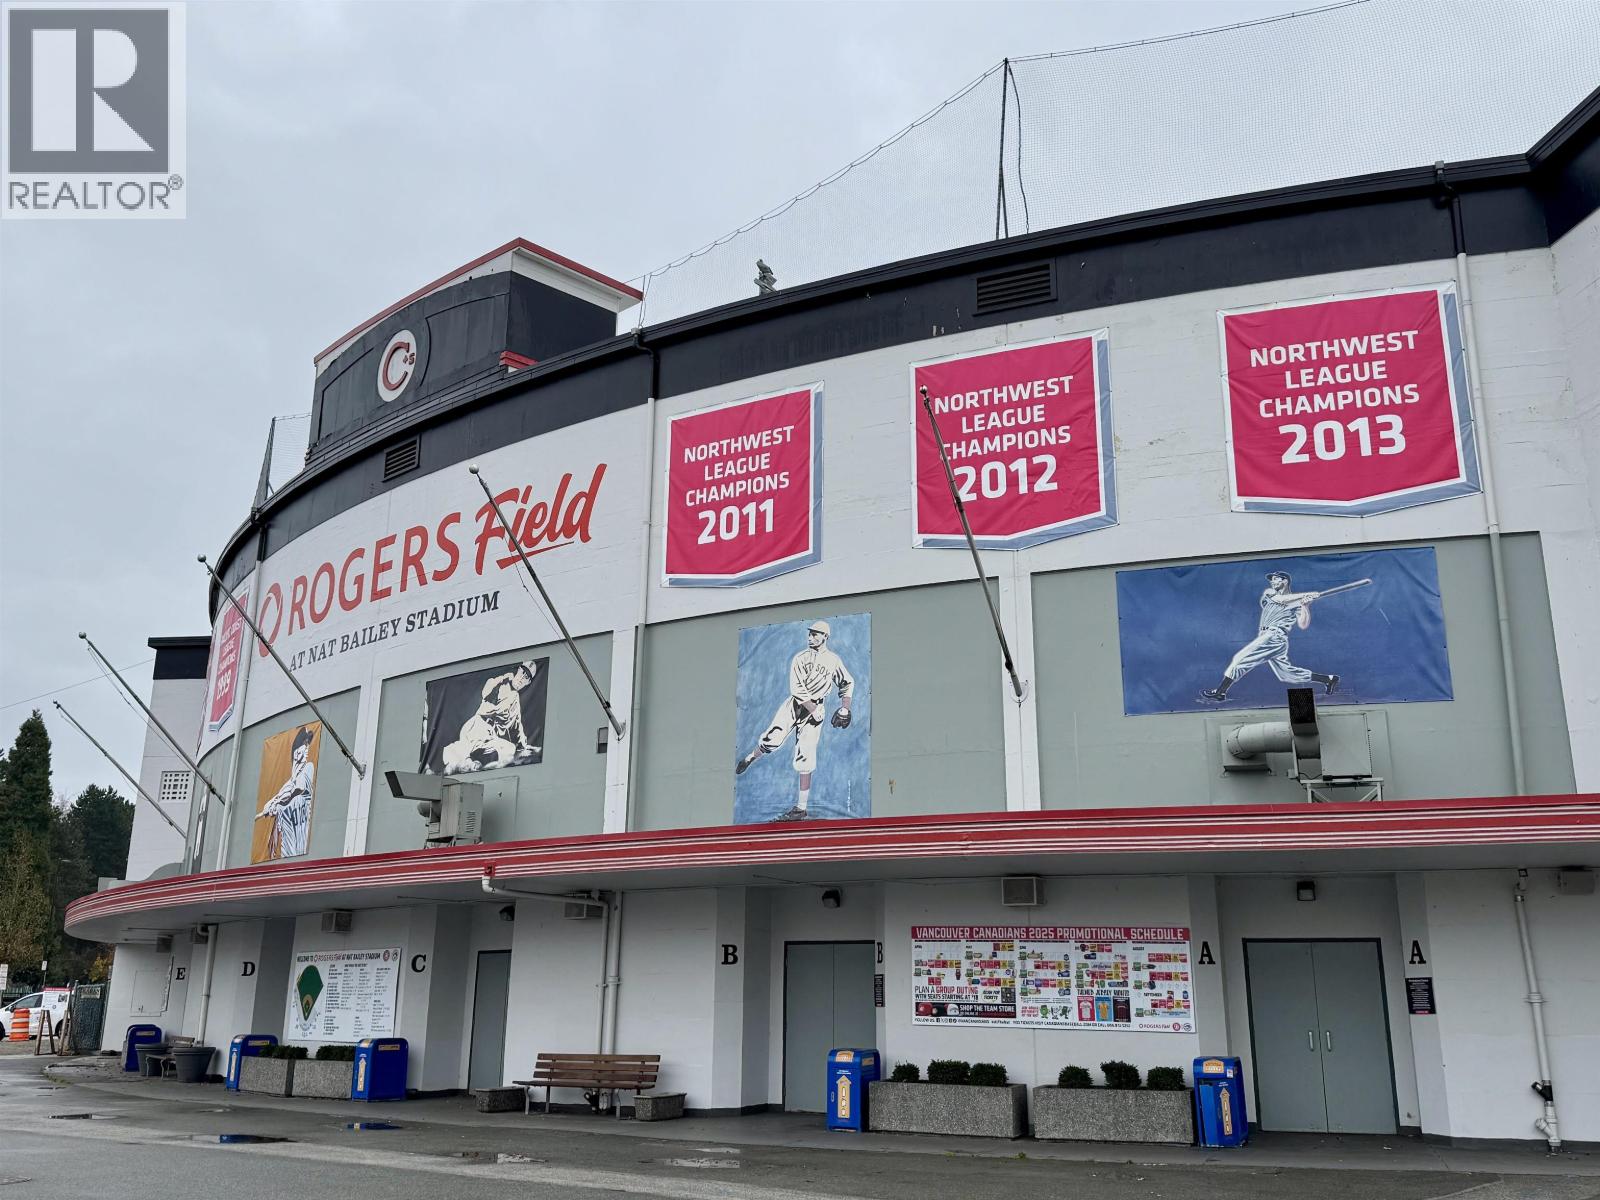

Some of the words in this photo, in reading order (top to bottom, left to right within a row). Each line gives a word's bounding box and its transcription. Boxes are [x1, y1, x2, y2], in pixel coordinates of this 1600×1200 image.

[1250, 330, 1419, 367] NORTHWEST
[1285, 360, 1387, 389] LEAGUE
[934, 375, 1074, 415] NORTHWEST
[1259, 383, 1420, 418] CHAMPIONS
[961, 404, 1046, 434] LEAGUE
[684, 425, 795, 464] NORTHWEST
[1278, 414, 1406, 464] 2013
[704, 453, 771, 481] LEAGUE
[953, 454, 1058, 503] 2012
[686, 472, 790, 507] CHAMPIONS
[697, 498, 774, 545] 2011
[288, 512, 461, 636] ROGERS
[474, 463, 607, 575] Field
[289, 650, 305, 672] AT
[308, 639, 336, 665] NAT
[340, 618, 401, 653] BAILEY
[405, 591, 500, 632] STADIUM
[916, 927, 970, 939] VANCOUVER
[973, 927, 1027, 939] CANADIANS
[1029, 928, 1055, 939] 2025
[1057, 928, 1127, 939] PROMOTIONAL
[1130, 929, 1184, 940] SCHEDULE
[411, 954, 427, 973] C
[721, 944, 739, 965] B
[876, 942, 883, 964] B
[1198, 941, 1216, 965] A
[1409, 940, 1427, 965] A
[176, 967, 186, 980] E
[241, 961, 256, 976] D
[936, 986, 954, 994] GROUP
[957, 986, 978, 994] OUTING
